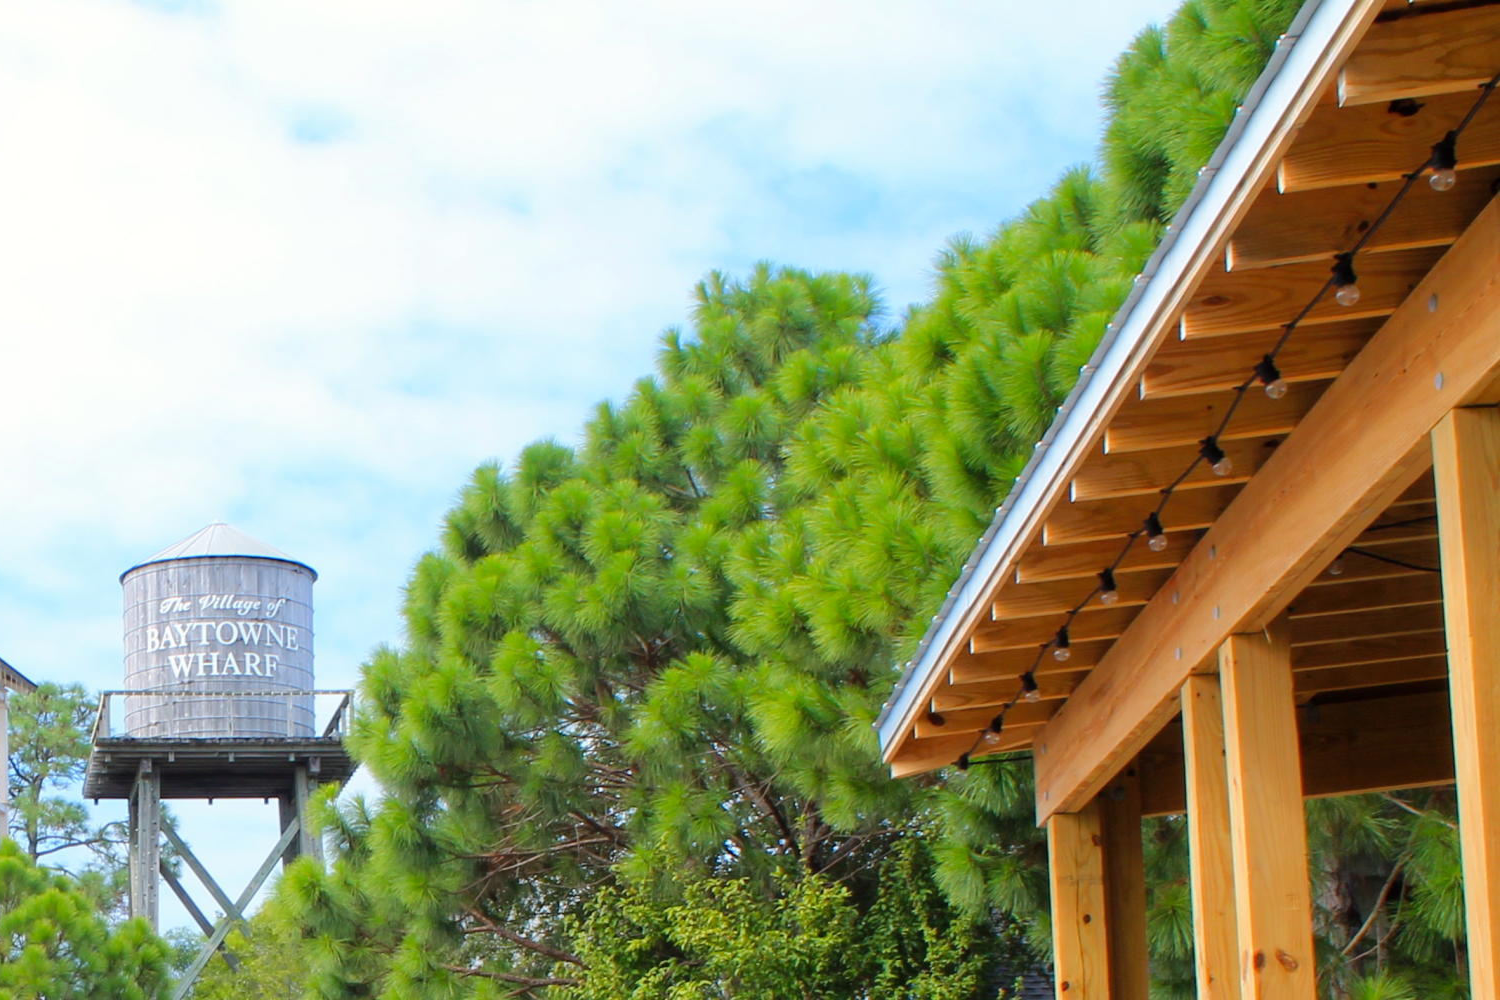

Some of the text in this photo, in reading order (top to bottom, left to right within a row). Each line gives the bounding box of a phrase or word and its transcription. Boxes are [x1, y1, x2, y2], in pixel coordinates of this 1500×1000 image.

[159, 594, 286, 618] The Village of
[146, 620, 300, 653] BAYTOWNE
[168, 651, 280, 679] WHARF
